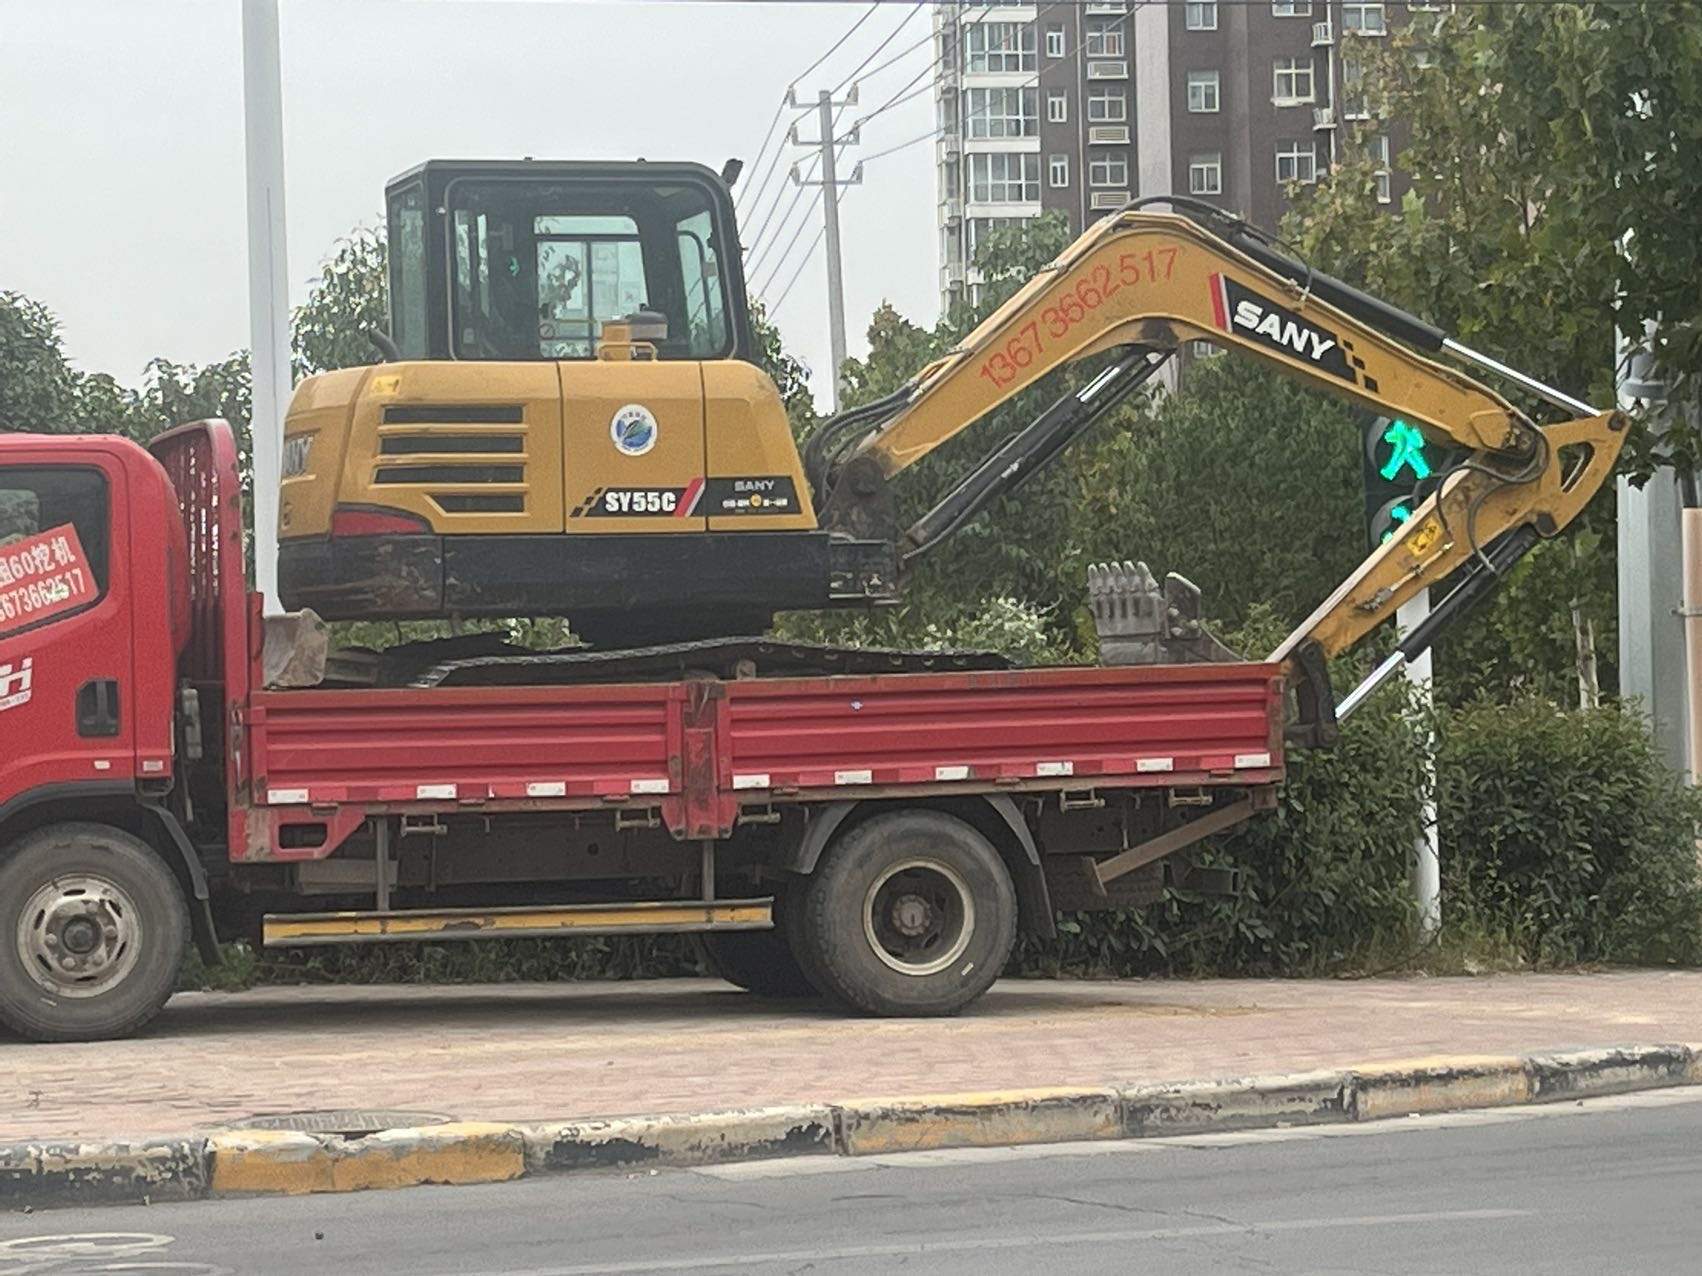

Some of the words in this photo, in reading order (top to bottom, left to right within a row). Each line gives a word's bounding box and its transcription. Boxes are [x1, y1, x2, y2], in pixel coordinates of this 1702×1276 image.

[980, 245, 1179, 389] 13673662517
[1233, 300, 1336, 360] SANY
[605, 491, 676, 512] SY55C
[734, 480, 775, 492] SANY
